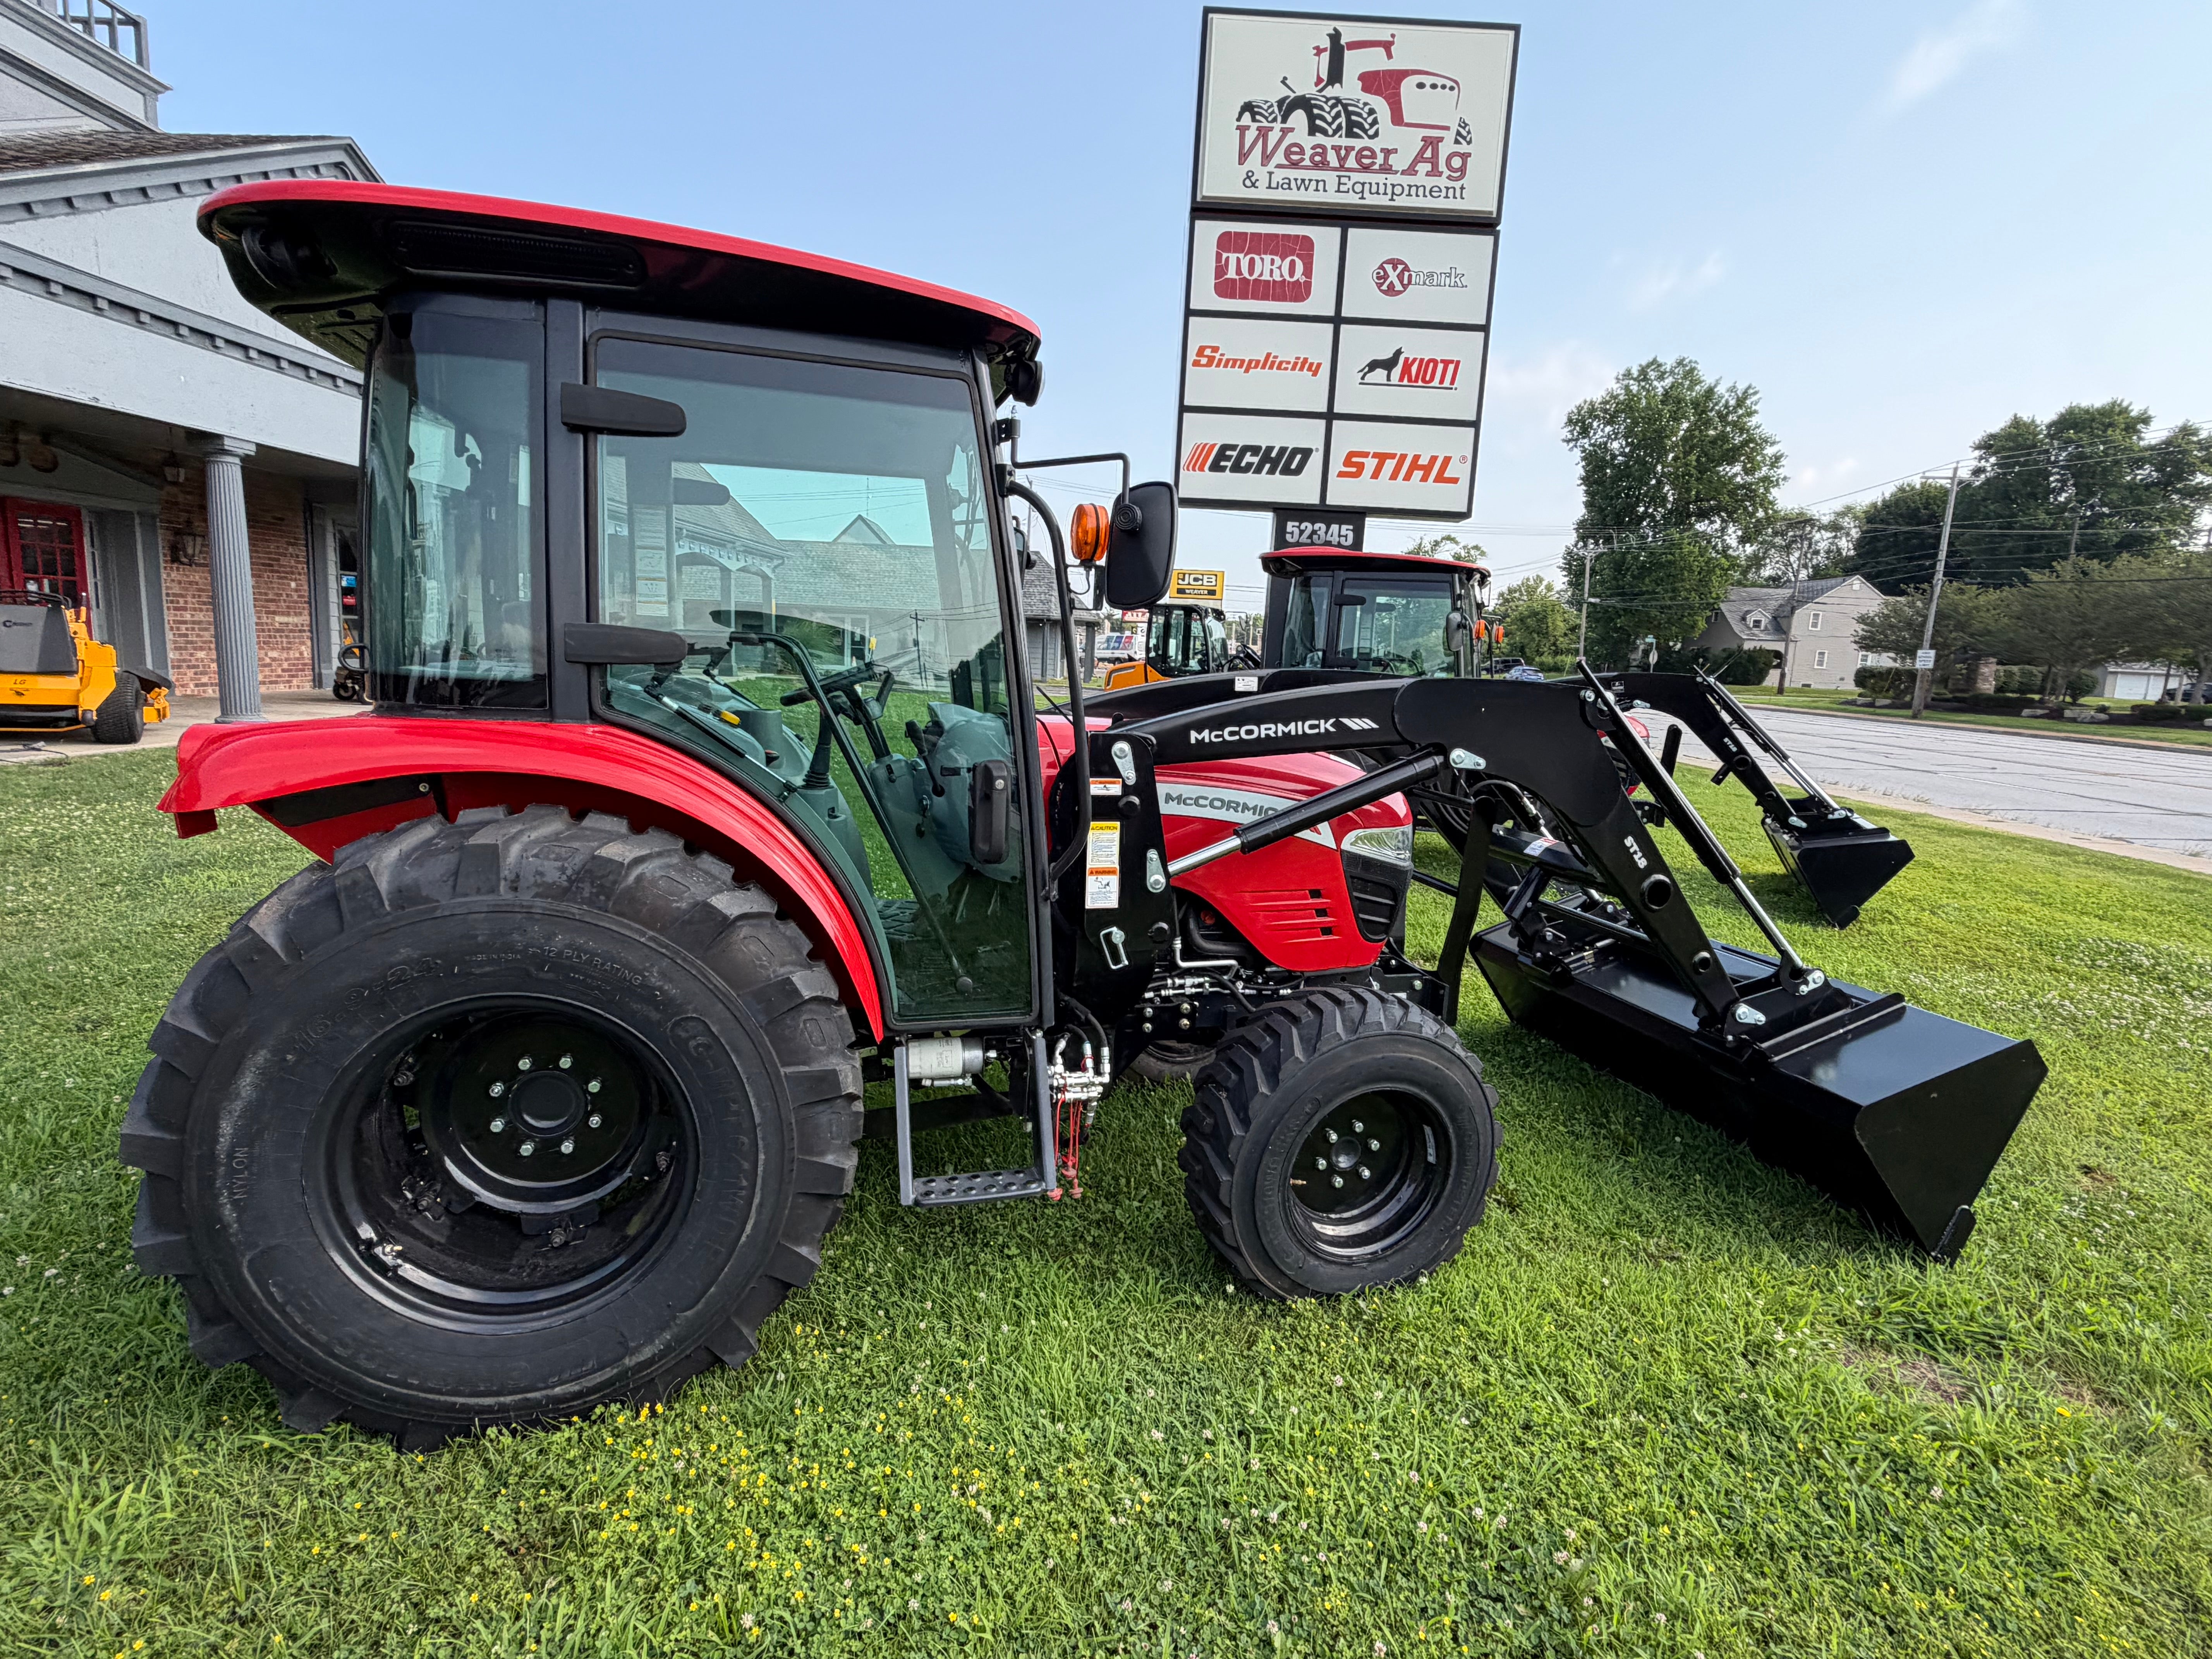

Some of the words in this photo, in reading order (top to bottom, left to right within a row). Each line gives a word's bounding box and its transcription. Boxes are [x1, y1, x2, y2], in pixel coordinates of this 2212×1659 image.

[1235, 124, 1398, 170] Weaver
[1401, 136, 1472, 181] Ag
[1242, 170, 1259, 189] &
[1266, 171, 1328, 192] Lawn
[1335, 175, 1466, 202] Equipment
[1221, 254, 1304, 282] TORO
[1192, 345, 1322, 377] Simplicity
[1398, 357, 1461, 386] KIOTI
[1209, 443, 1314, 477] ECHO
[1337, 450, 1460, 484] STIHL
[1286, 521, 1354, 546] 52345
[1178, 573, 1216, 586] JCB
[1190, 718, 1336, 744] McCORMICK
[1164, 792, 1278, 817] McCORMIC
[1624, 836, 1647, 869] ST18
[563, 949, 590, 962] PLY
[593, 957, 642, 986] RATING
[232, 1147, 249, 1199] NYLON
